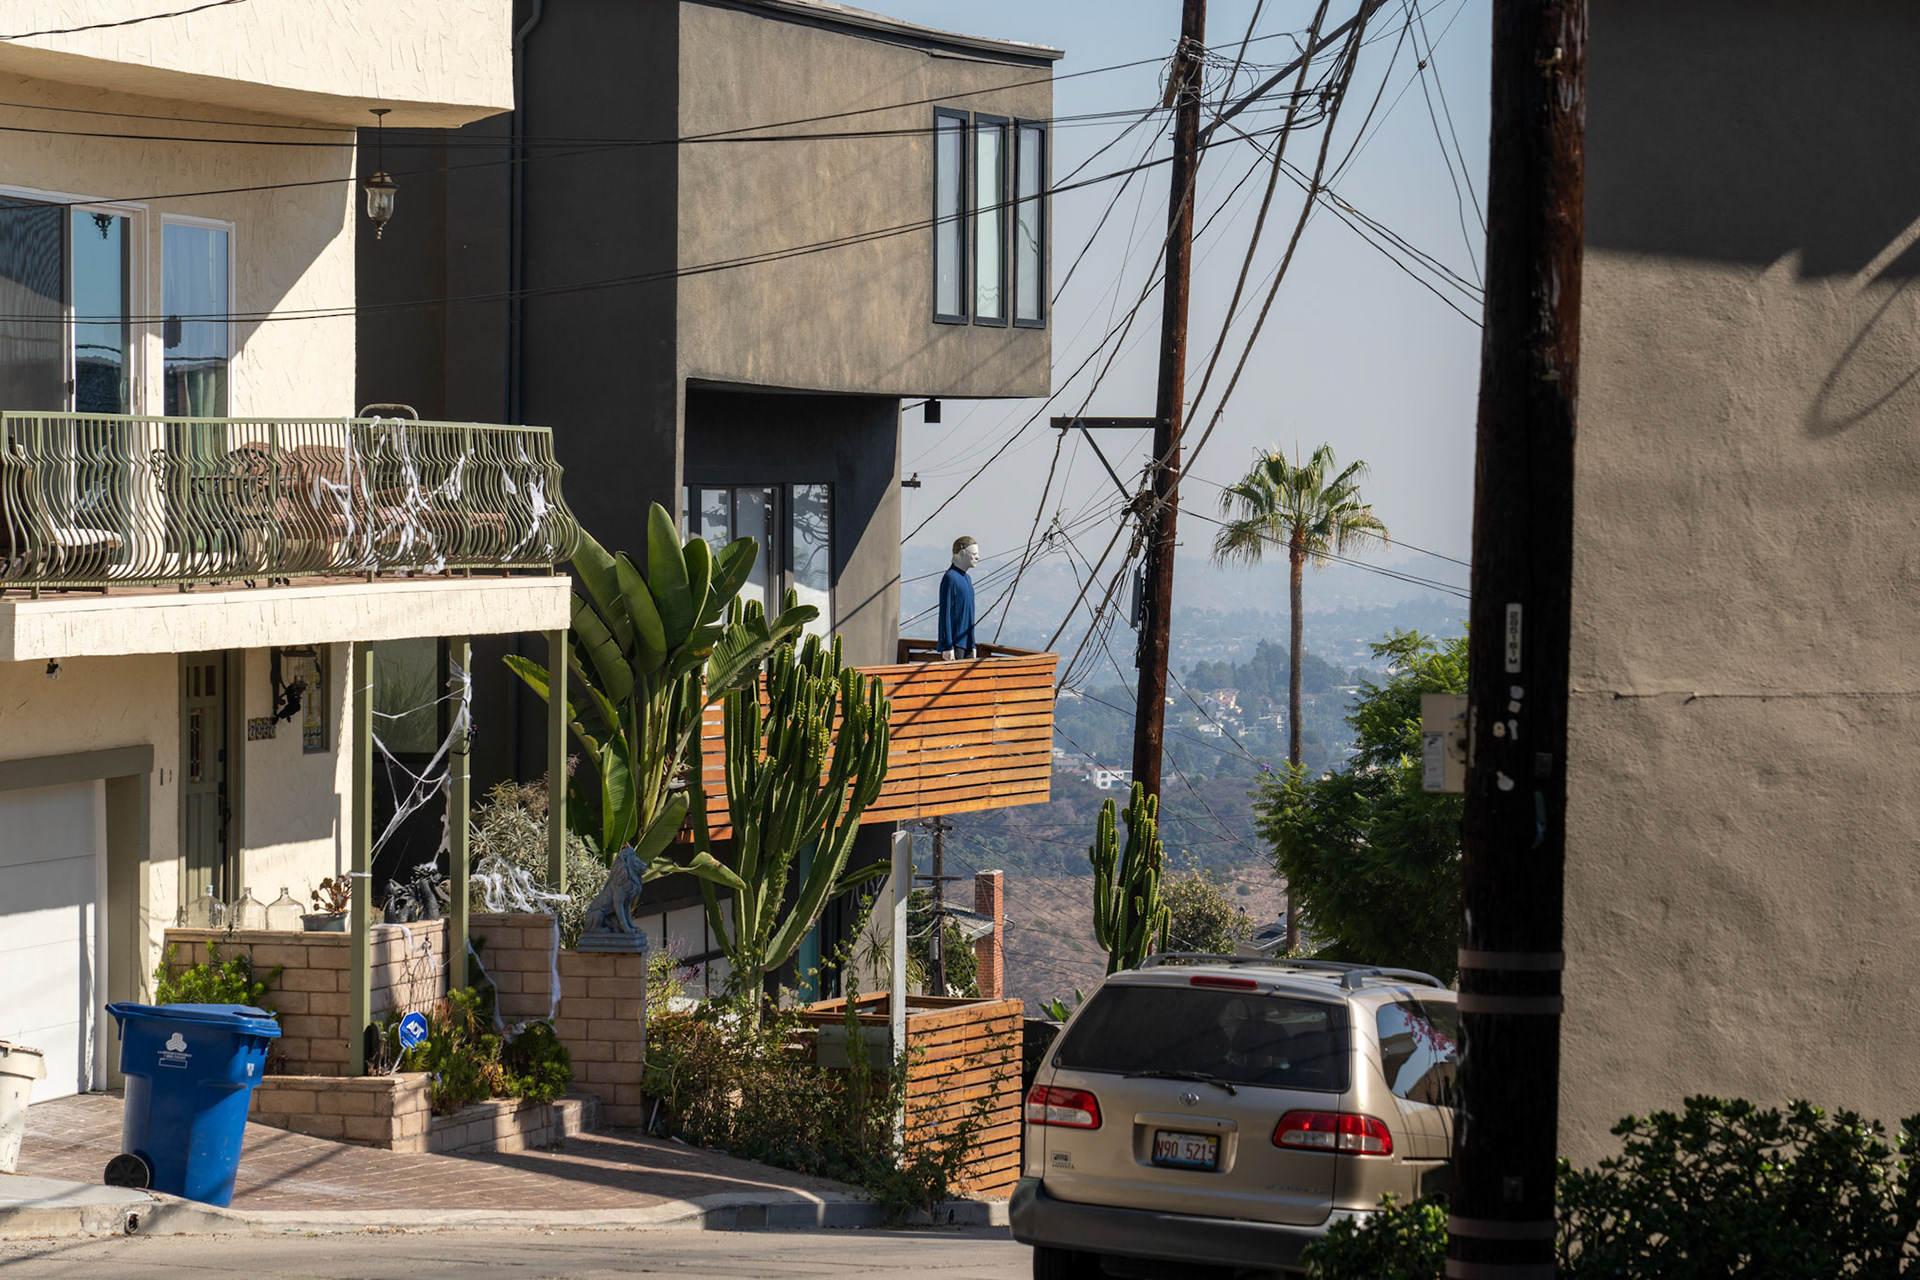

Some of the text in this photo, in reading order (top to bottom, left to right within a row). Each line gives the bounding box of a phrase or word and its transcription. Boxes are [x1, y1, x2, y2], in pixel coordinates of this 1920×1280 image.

[406, 1020, 425, 1038] ADT
[1156, 1140, 1216, 1161] N90 5215
